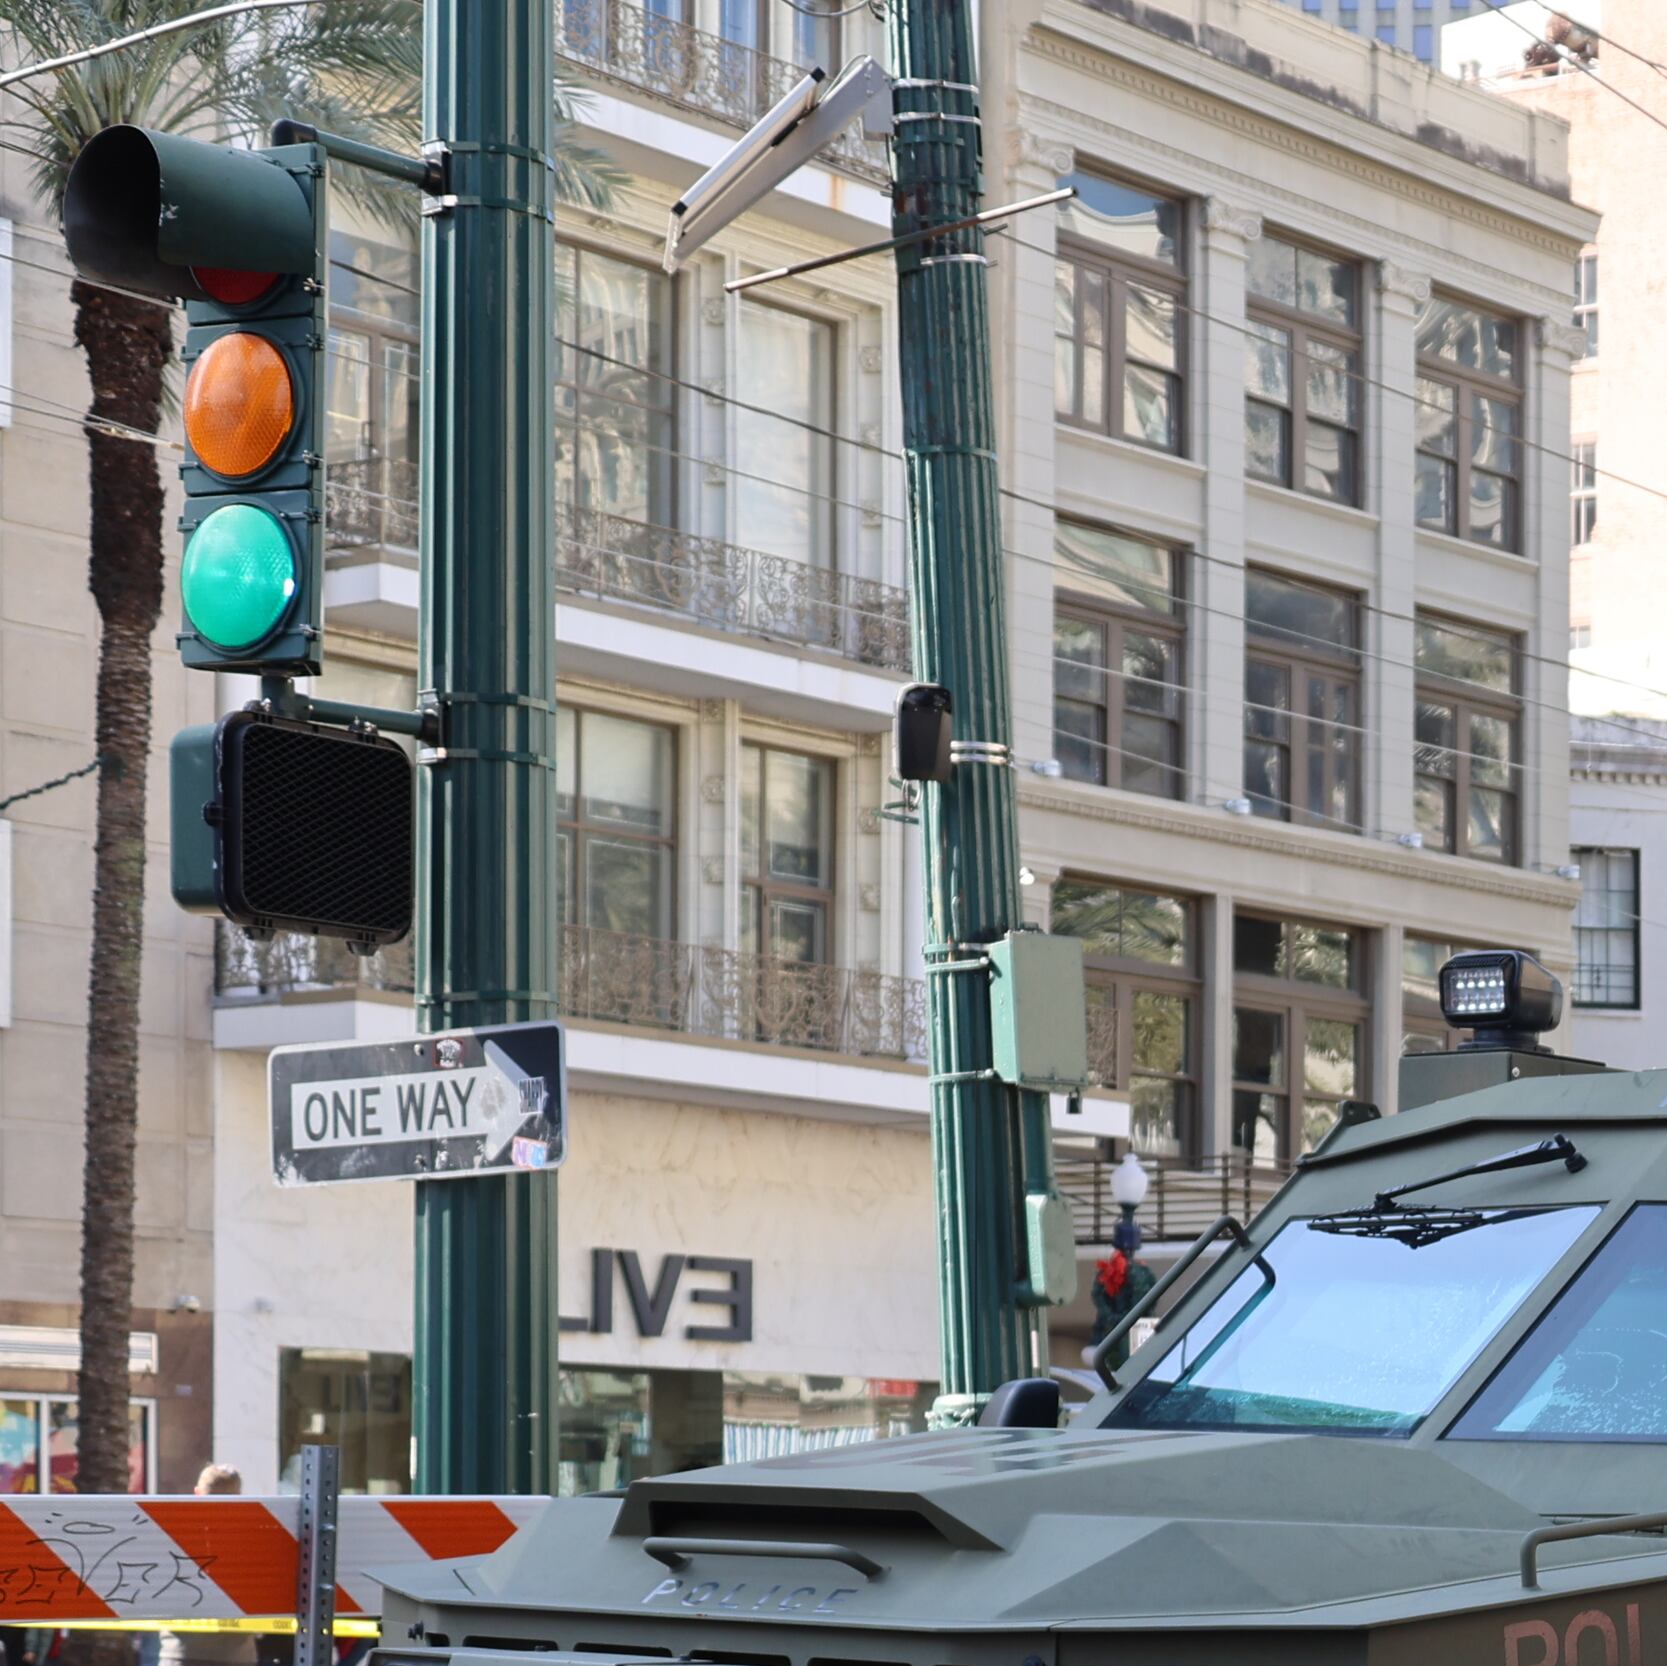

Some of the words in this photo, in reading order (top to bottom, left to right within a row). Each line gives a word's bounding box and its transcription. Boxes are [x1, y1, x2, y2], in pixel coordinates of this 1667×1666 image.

[303, 1086, 382, 1142] ONE
[397, 1076, 476, 1134] WAY
[641, 1578, 859, 1614] POLICE
